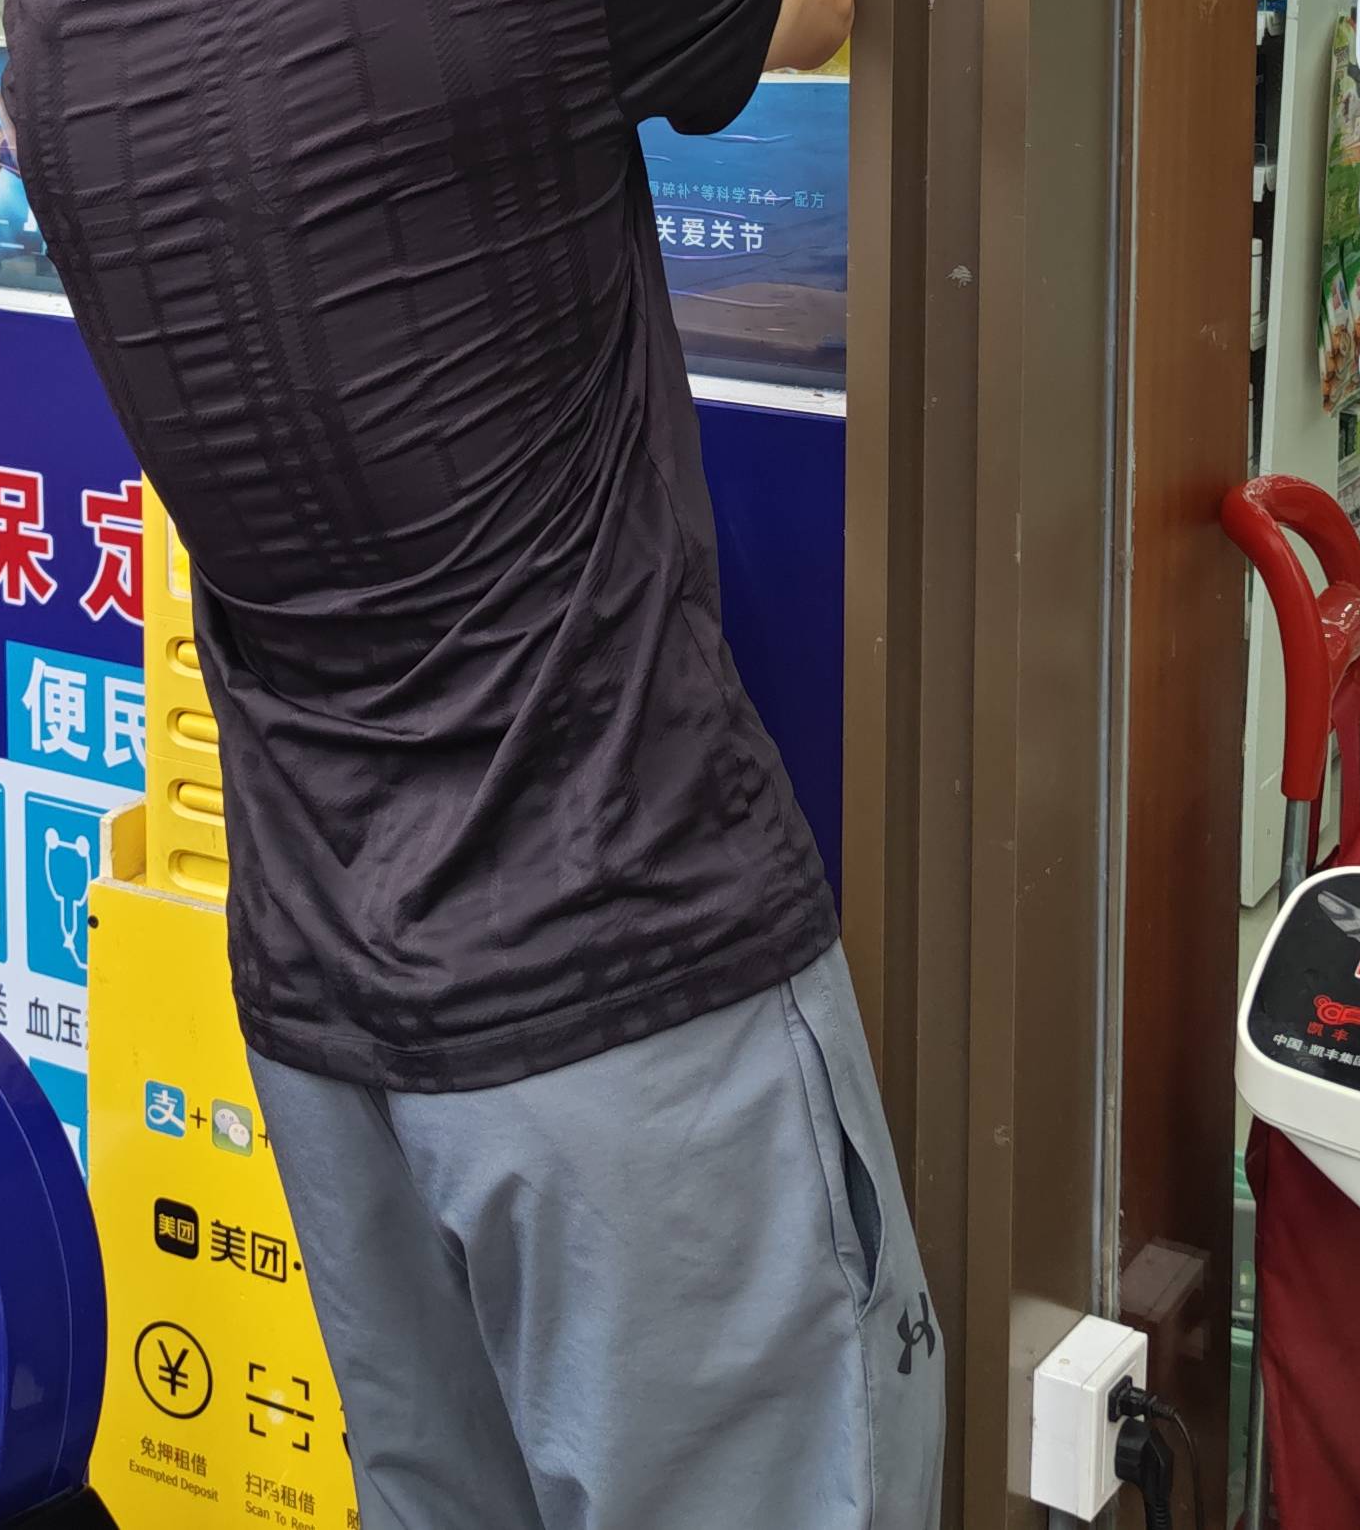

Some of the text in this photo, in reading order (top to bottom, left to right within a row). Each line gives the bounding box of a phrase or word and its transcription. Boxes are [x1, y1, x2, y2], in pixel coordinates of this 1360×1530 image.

[158, 1212, 195, 1245] 美团
[140, 1435, 208, 1478] 免押租借
[129, 1458, 220, 1503] Exempted Deposit
[245, 1471, 316, 1516] 扫码租借
[245, 1500, 271, 1520] Scan
[275, 1510, 287, 1525] To
